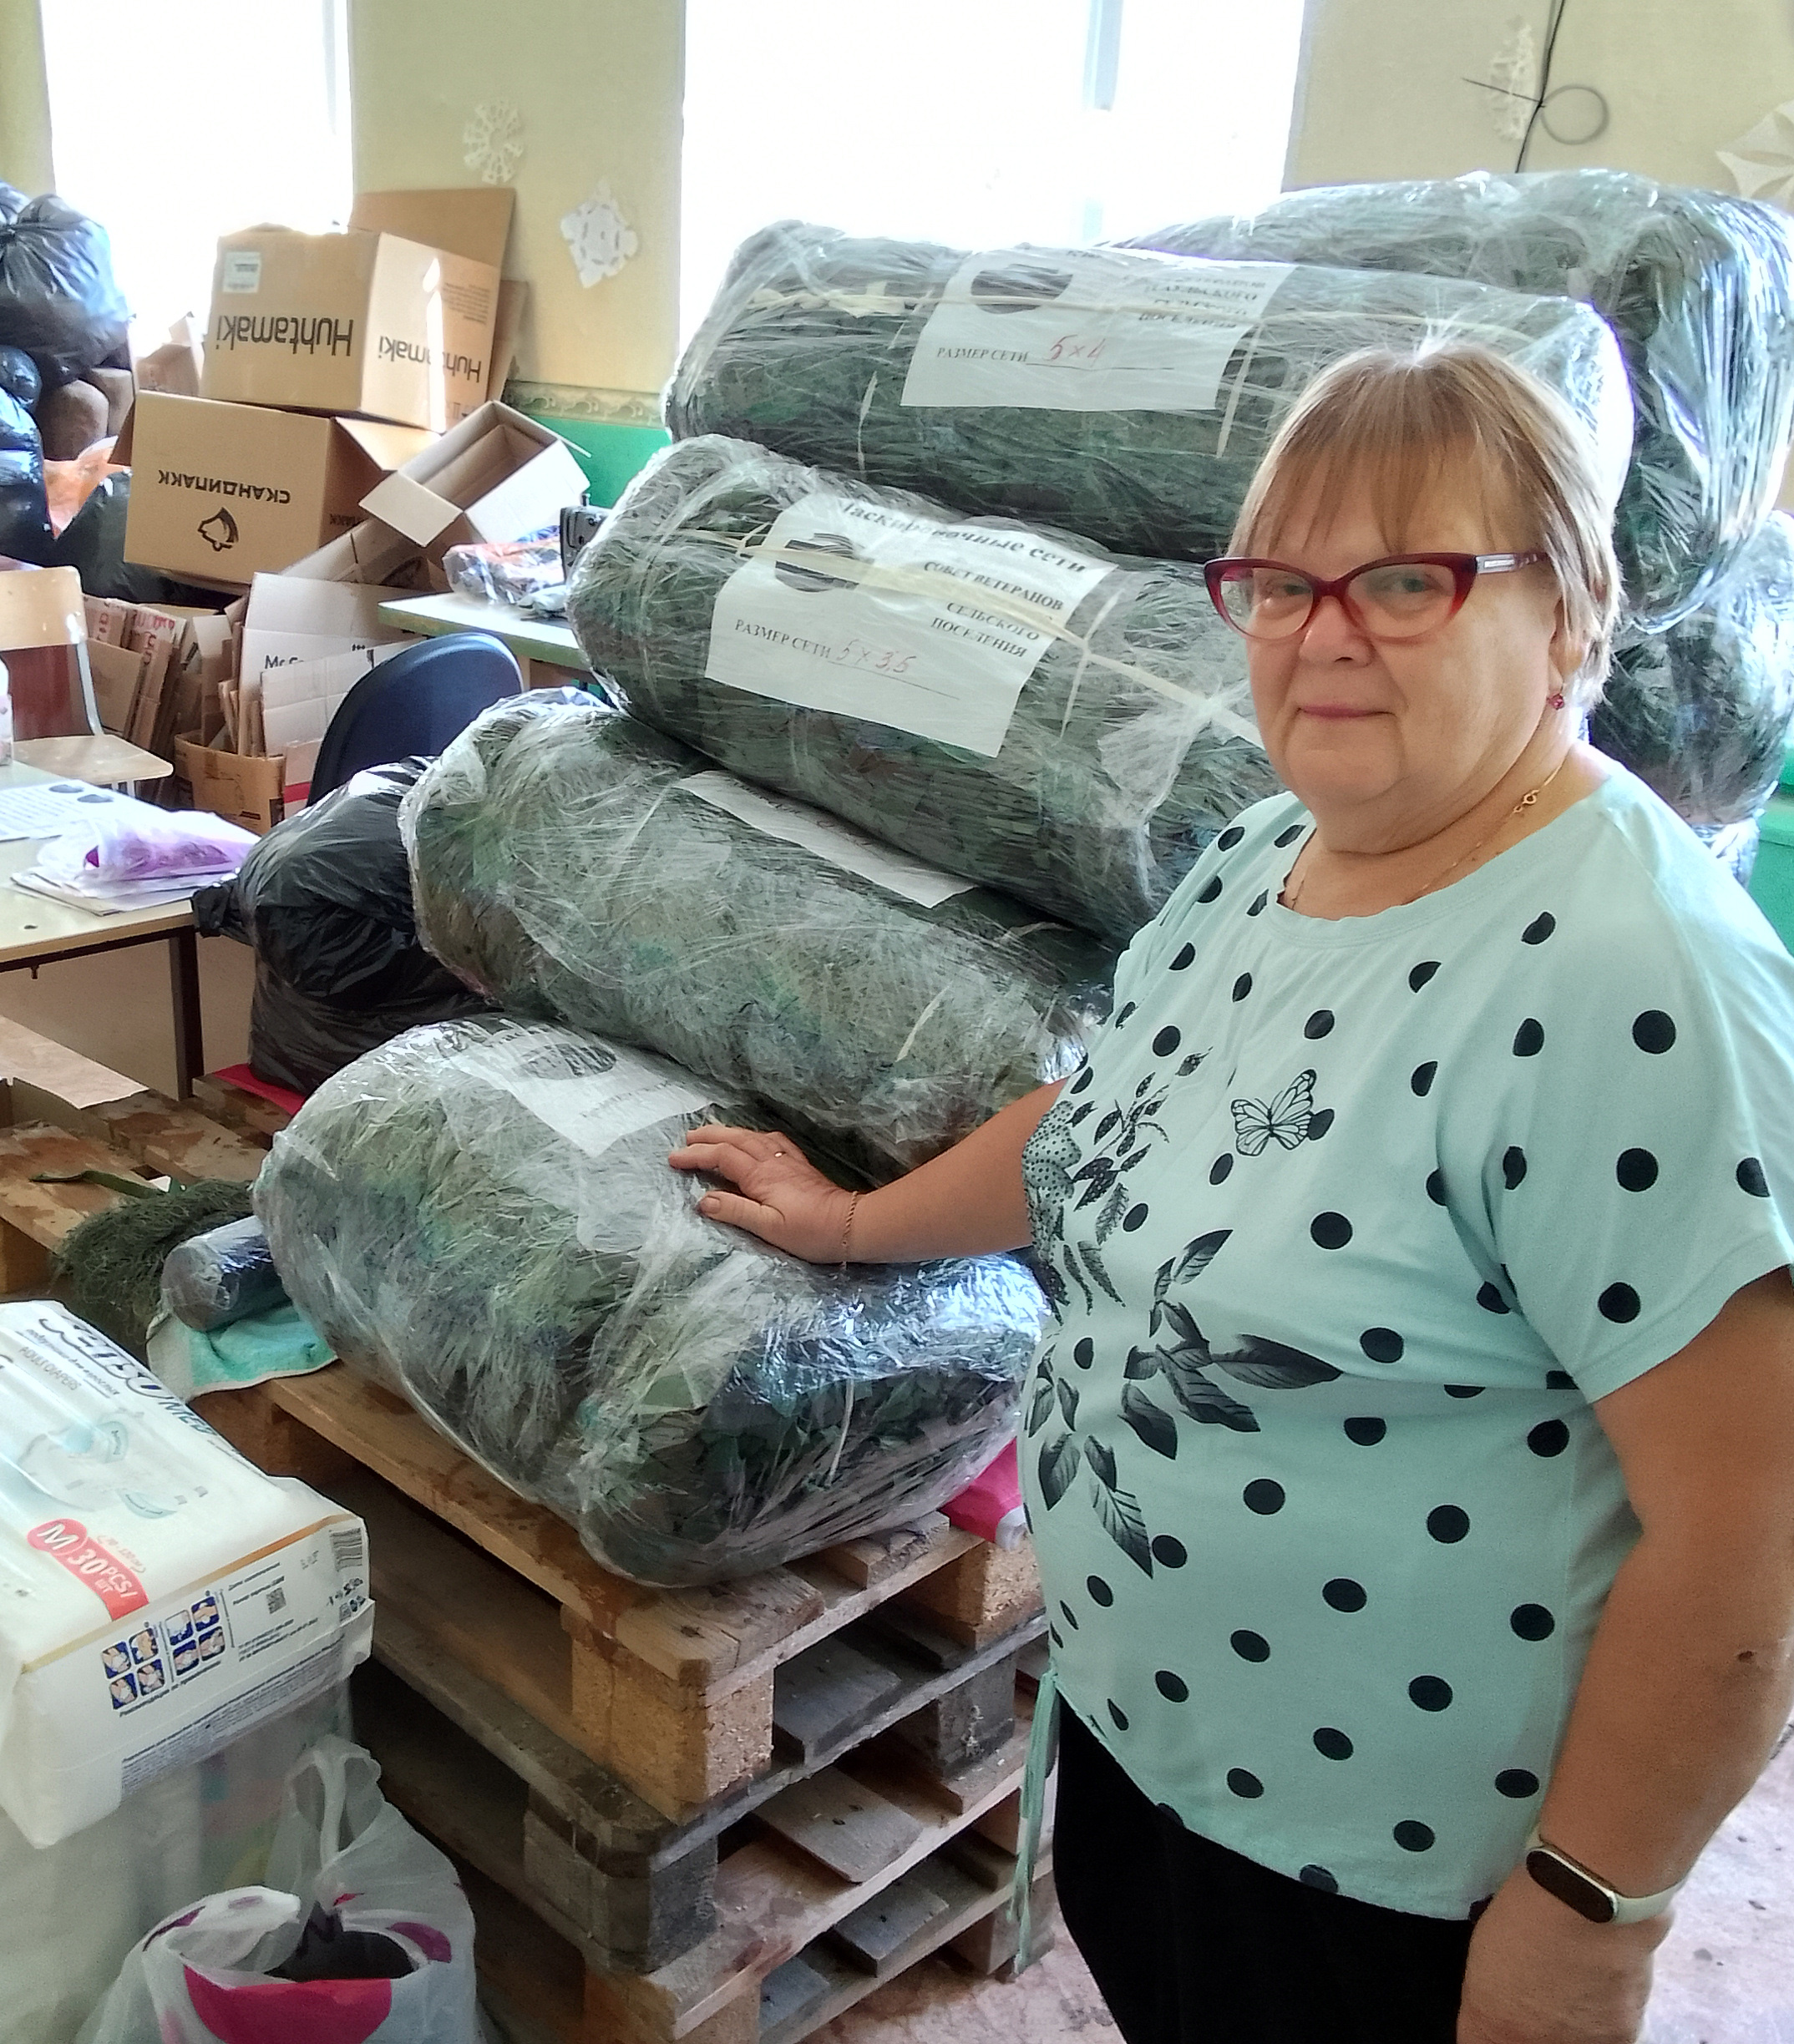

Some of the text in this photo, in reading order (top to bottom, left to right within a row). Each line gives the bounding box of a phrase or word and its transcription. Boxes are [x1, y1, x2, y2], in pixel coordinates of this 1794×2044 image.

[215, 315, 354, 357] Huhtamaki
[936, 347, 1029, 362] РАЗМЕР СЕТИ
[378, 336, 482, 382] Huhmaki
[158, 469, 291, 504] СКАНДИПАКК
[1029, 547, 1087, 574] сети
[924, 560, 1065, 611] СОВЕТ ВЕТЕРАНОВ
[735, 619, 832, 660] РАЗМЕР СЕТИ
[930, 616, 1028, 659] ПОСЕЛЕНИЯ
[946, 601, 1041, 642] СЕЛЬСКОГО
[37, 1523, 79, 1551] M
[67, 1548, 109, 1575] 30
